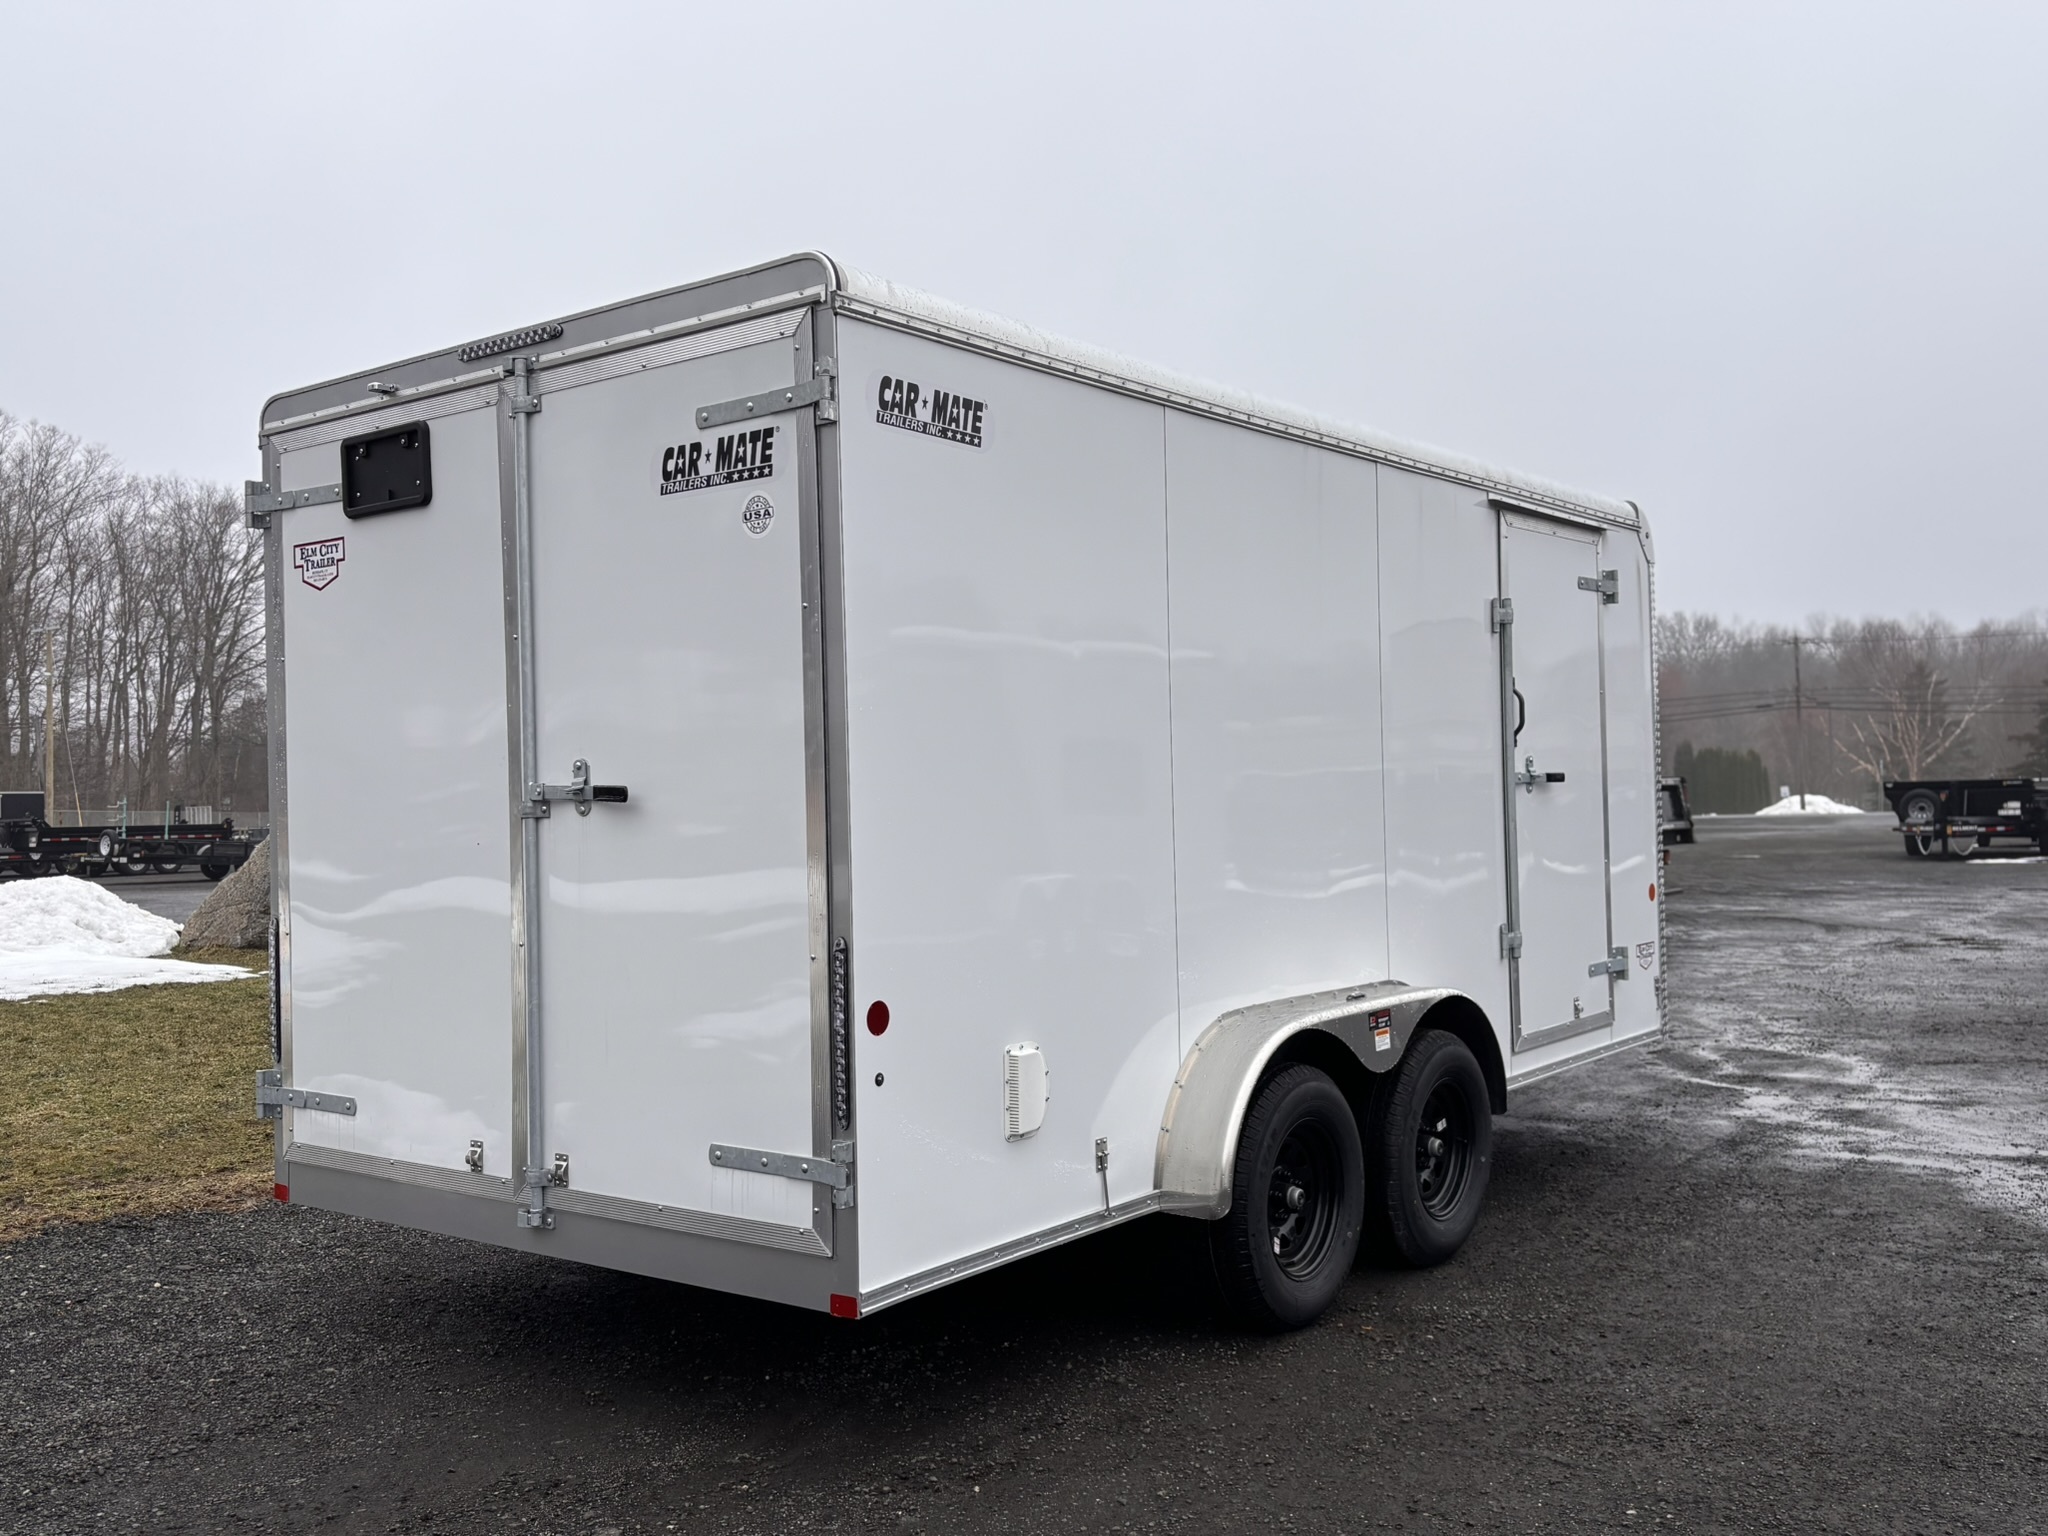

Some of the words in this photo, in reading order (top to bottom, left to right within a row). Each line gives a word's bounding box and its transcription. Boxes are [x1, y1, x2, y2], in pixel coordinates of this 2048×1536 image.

[878, 375, 920, 418] CAR
[931, 389, 984, 435] MATE
[878, 411, 924, 432] TRAILERS
[926, 422, 945, 437] INC.
[662, 441, 702, 482] CAR
[715, 426, 774, 473] MATE
[661, 476, 708, 494] TRAILERS
[709, 472, 730, 483] INC.
[744, 508, 771, 521] USA
[300, 547, 318, 560] ELM
[319, 543, 340, 557] CITY
[304, 556, 336, 572] TRAILER
